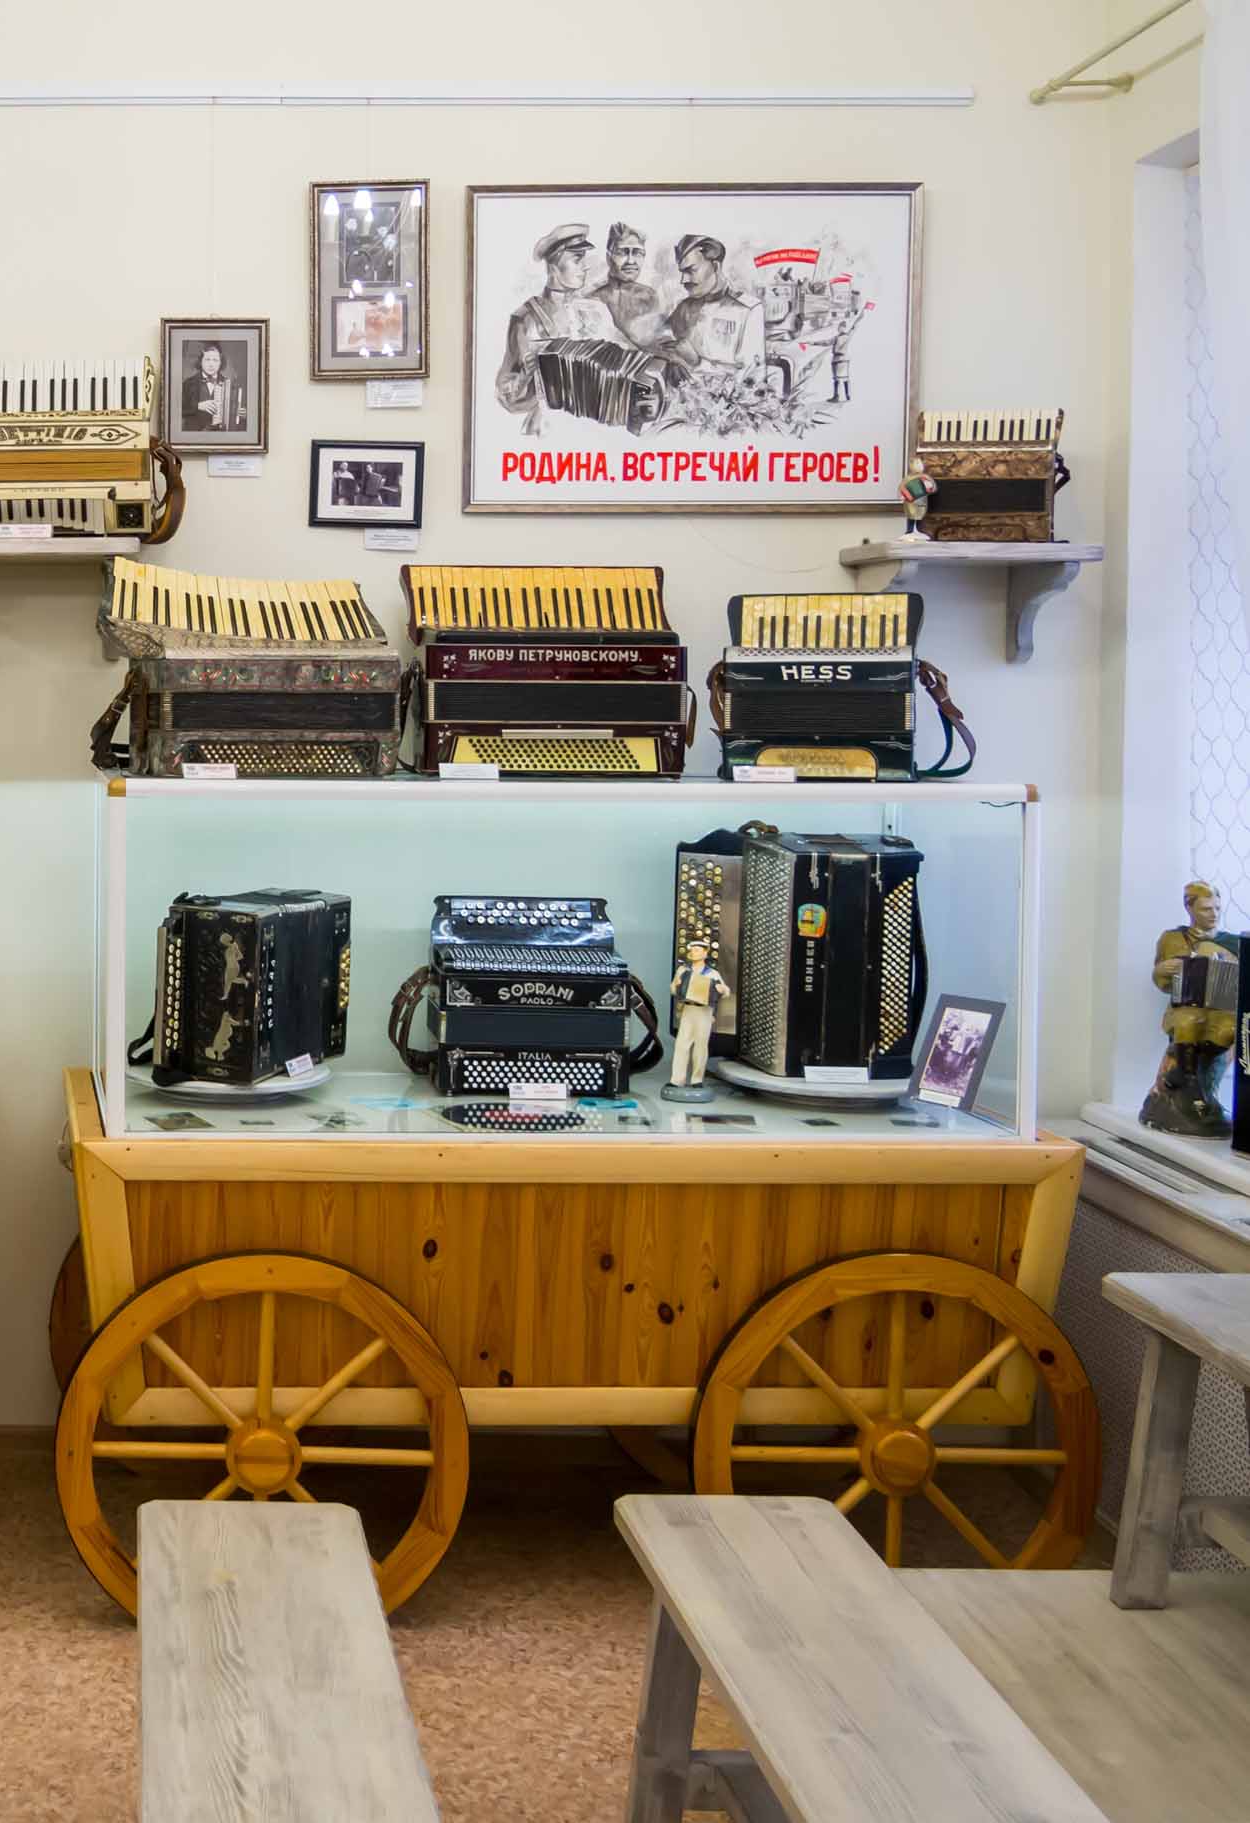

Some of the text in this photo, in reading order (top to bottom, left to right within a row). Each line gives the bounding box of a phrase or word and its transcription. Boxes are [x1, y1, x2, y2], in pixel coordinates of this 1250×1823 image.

[502, 445, 881, 484] РОДИНА, ВСТРЕЧАЙ ГЕРОЕВ!
[469, 649, 643, 662] ЯКОВУ ПЕТРУНОВСКОМУ.
[780, 665, 853, 681] HESS
[498, 982, 575, 1001] SOPRANI
[518, 1052, 552, 1061] ITALIA
